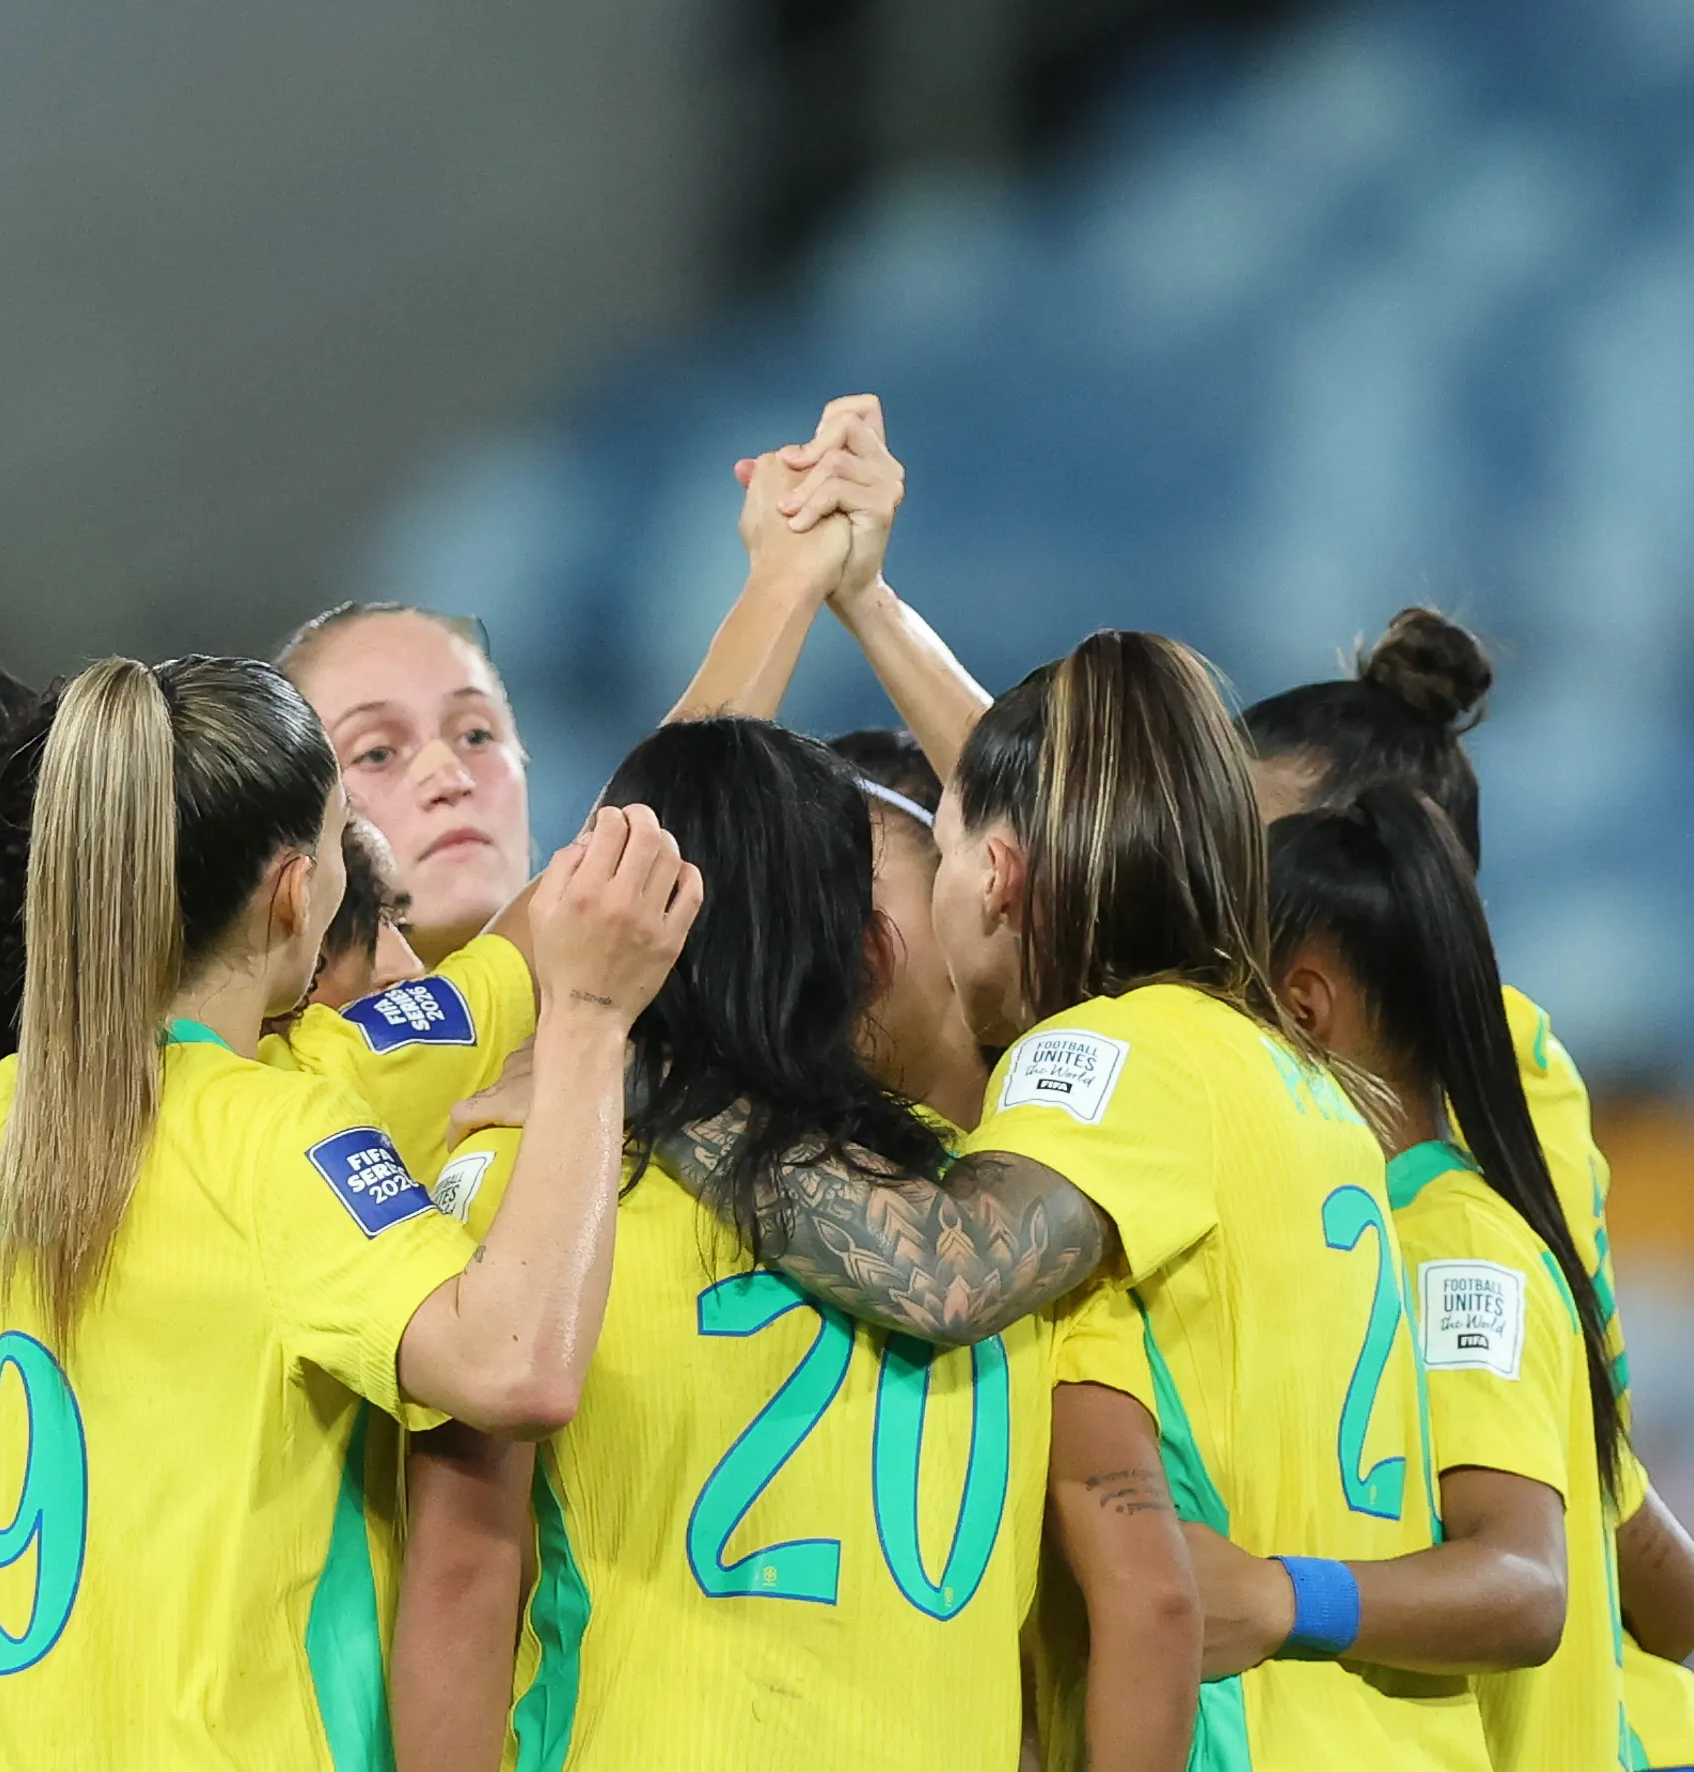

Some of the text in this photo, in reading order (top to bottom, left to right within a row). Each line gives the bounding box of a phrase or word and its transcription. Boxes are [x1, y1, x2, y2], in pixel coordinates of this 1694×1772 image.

[373, 999, 407, 1025] FIFA
[1032, 1050, 1097, 1072] UNITES
[1036, 1040, 1098, 1058] FOOTBALL
[1050, 1063, 1096, 1088] World
[346, 1148, 395, 1172] FIFA
[1443, 1278, 1504, 1296] FOOTBALL
[1443, 1293, 1504, 1317] UNITES
[1321, 1184, 1435, 1538] 2
[686, 1270, 1011, 1622] 20
